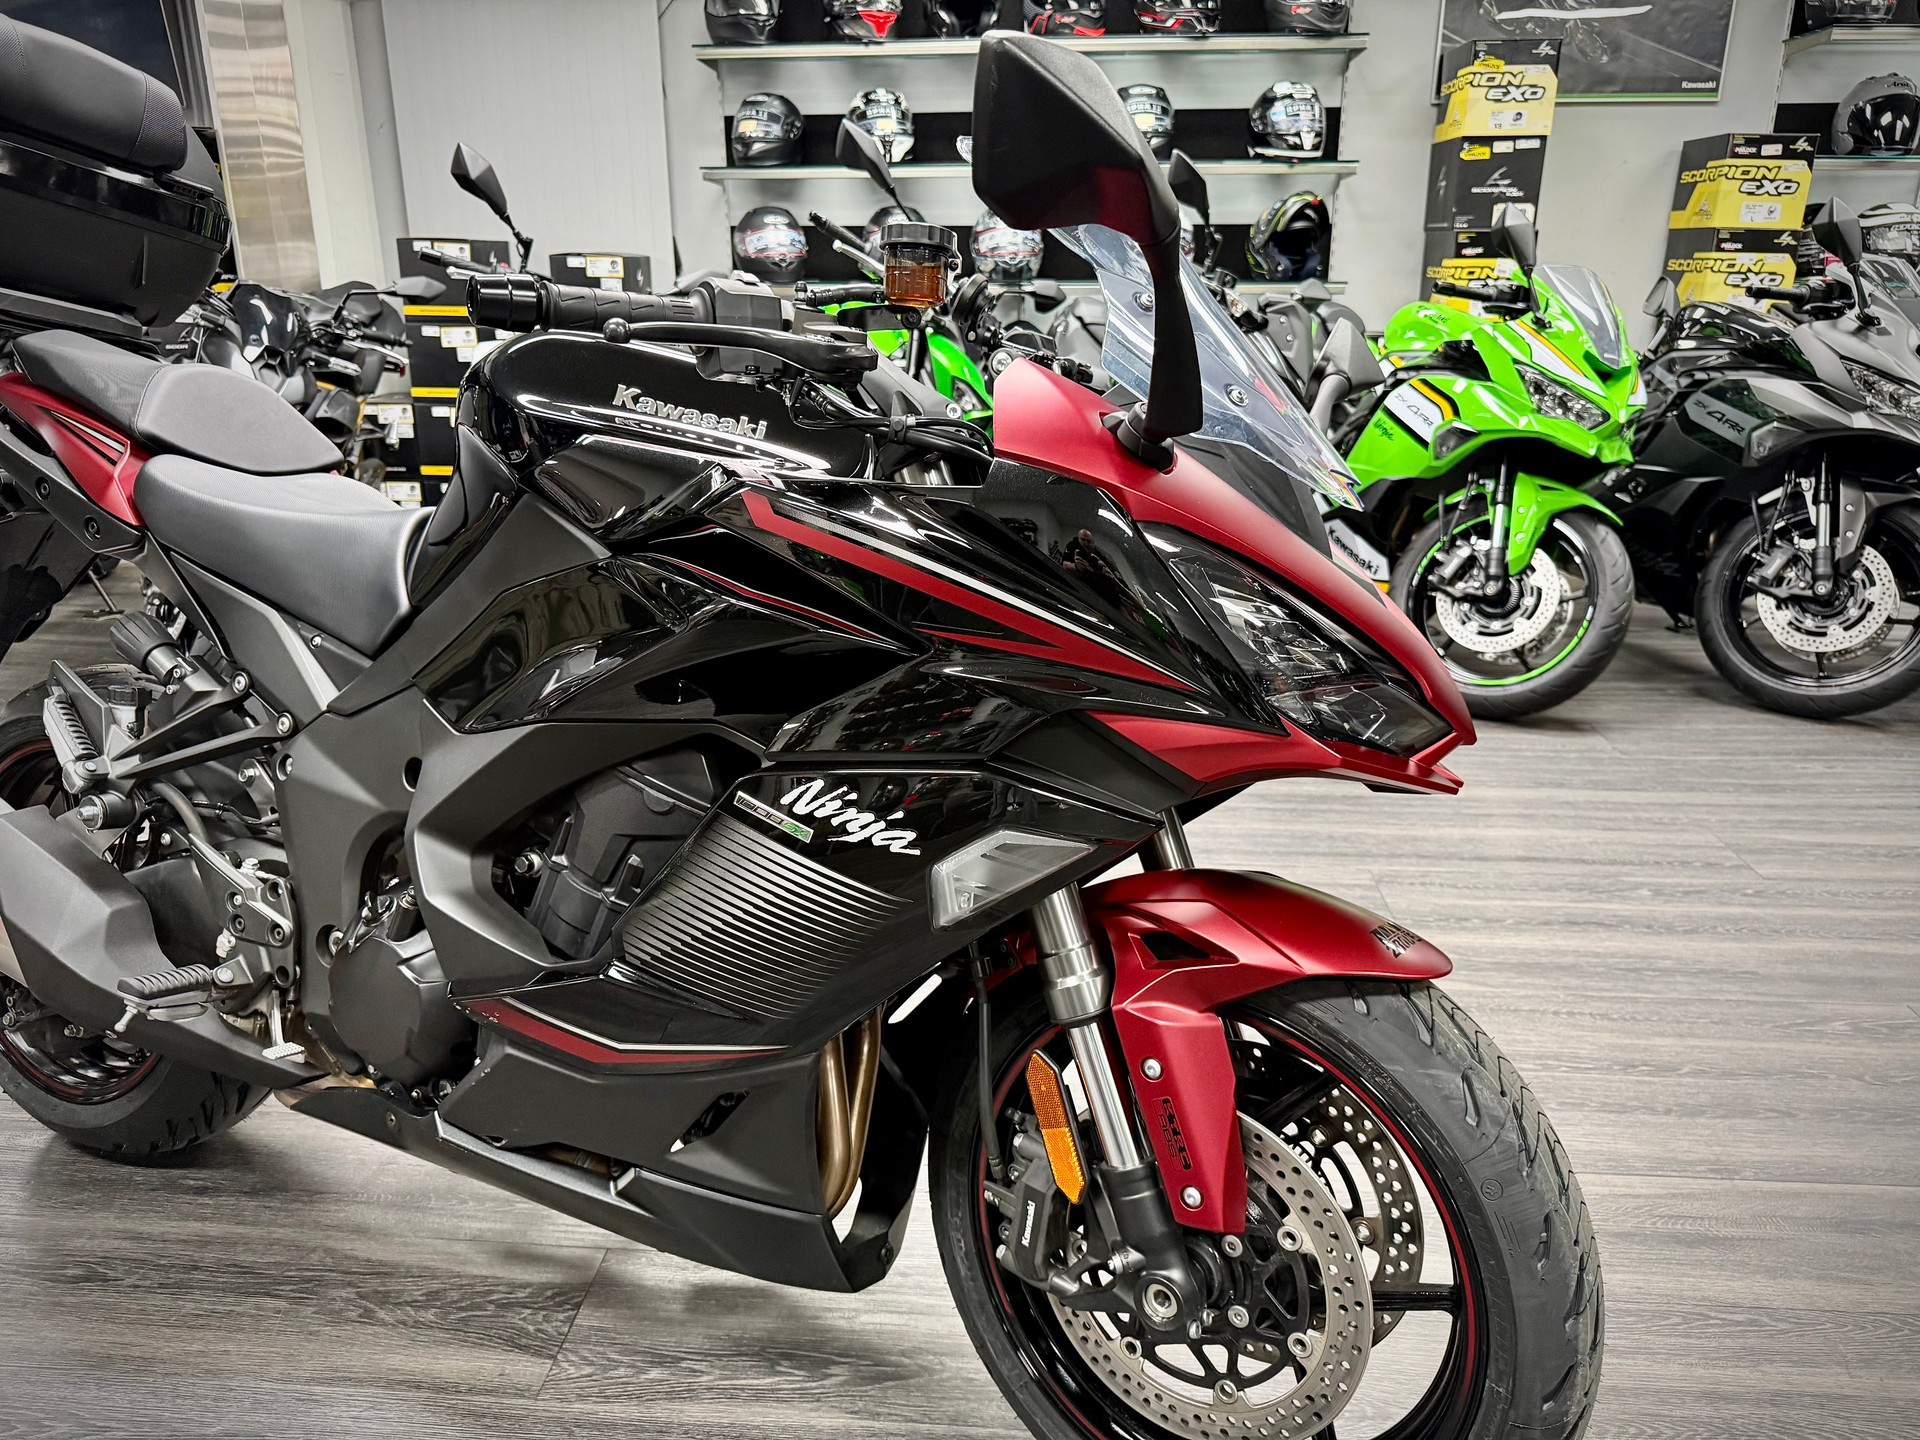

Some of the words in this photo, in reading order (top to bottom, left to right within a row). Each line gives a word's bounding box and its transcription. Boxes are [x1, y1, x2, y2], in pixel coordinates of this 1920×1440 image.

[1681, 81, 1716, 89] Kawasaki
[1680, 165, 1782, 183] SCORPION
[1739, 179, 1801, 196] EXO
[612, 383, 768, 441] Kawasaki
[1328, 526, 1379, 576] Kawasaki
[778, 778, 921, 856] Ninja
[1021, 1200, 1036, 1247] Kawasaki
